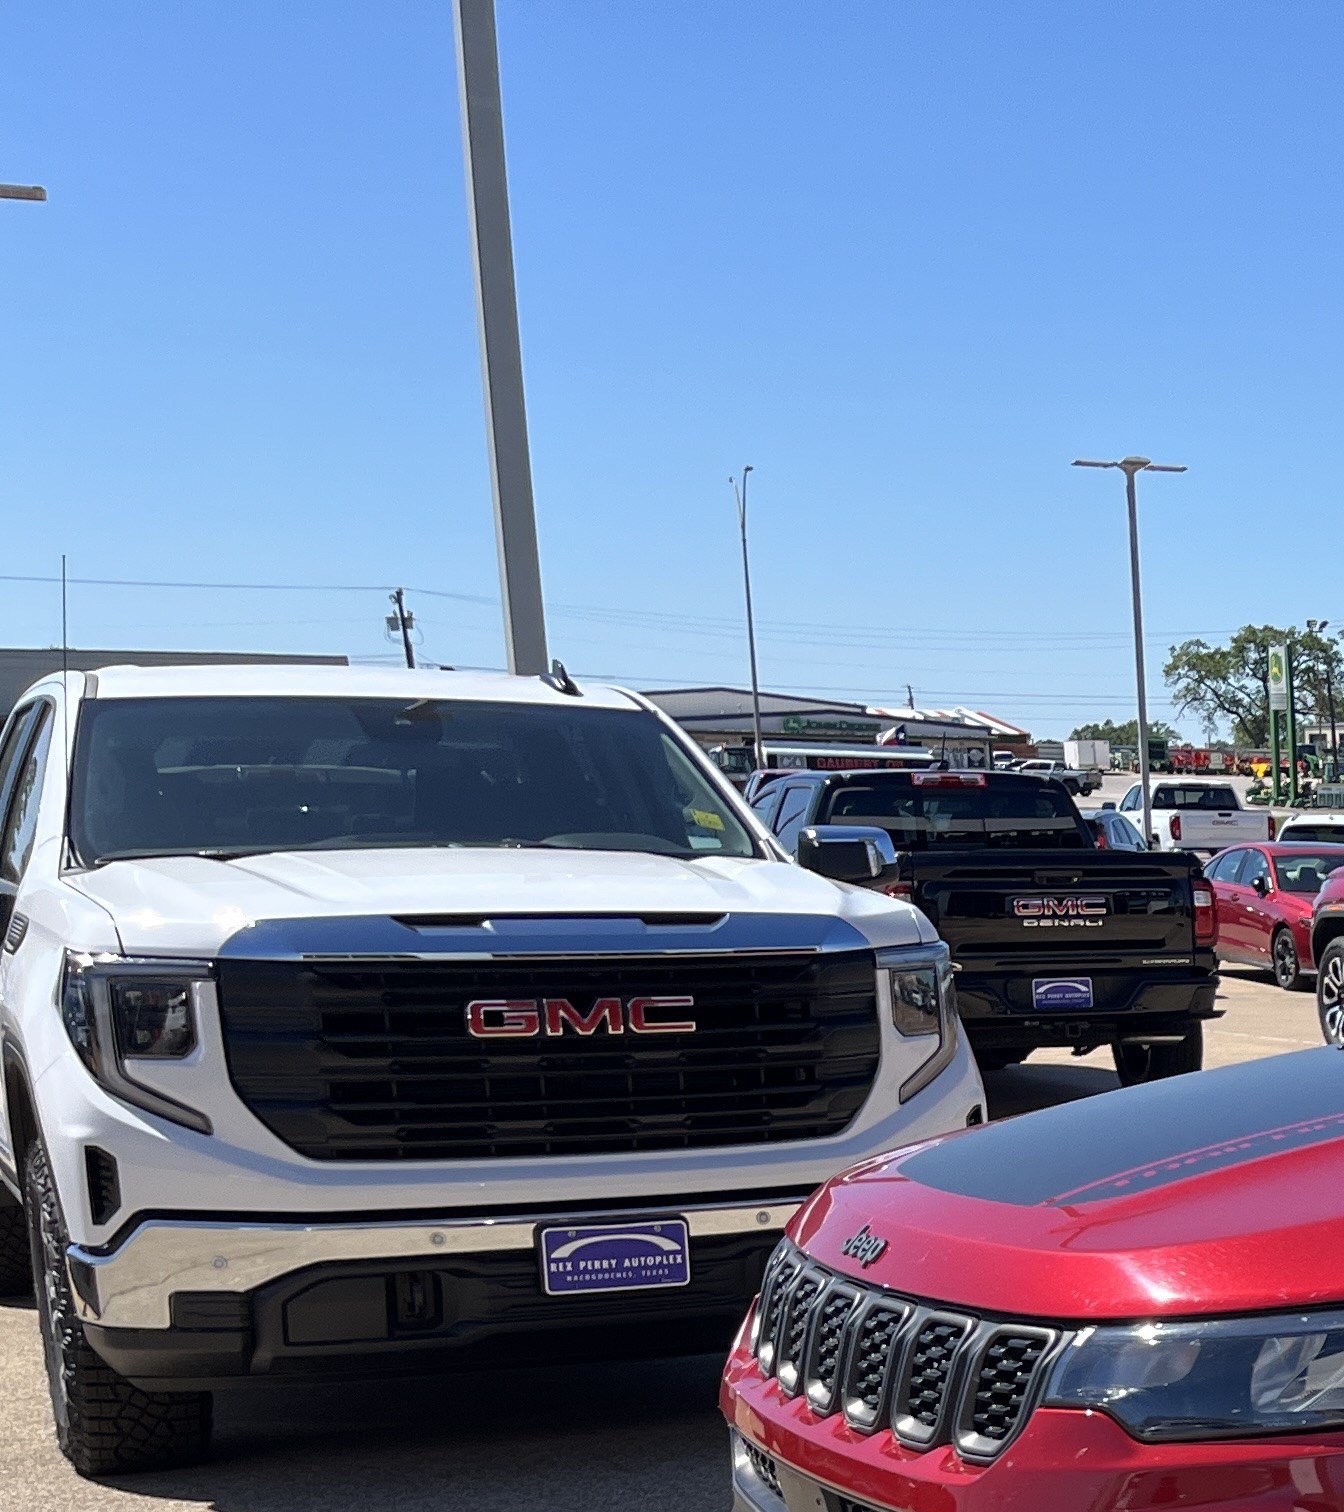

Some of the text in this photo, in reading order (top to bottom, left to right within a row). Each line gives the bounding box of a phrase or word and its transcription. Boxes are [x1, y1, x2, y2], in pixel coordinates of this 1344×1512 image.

[1013, 896, 1107, 916] GMC
[1023, 919, 1103, 927] DENALI
[467, 996, 696, 1038] GMC
[841, 1225, 888, 1270] Jeep
[550, 1254, 683, 1272] REX PERRY AUTOPLEX
